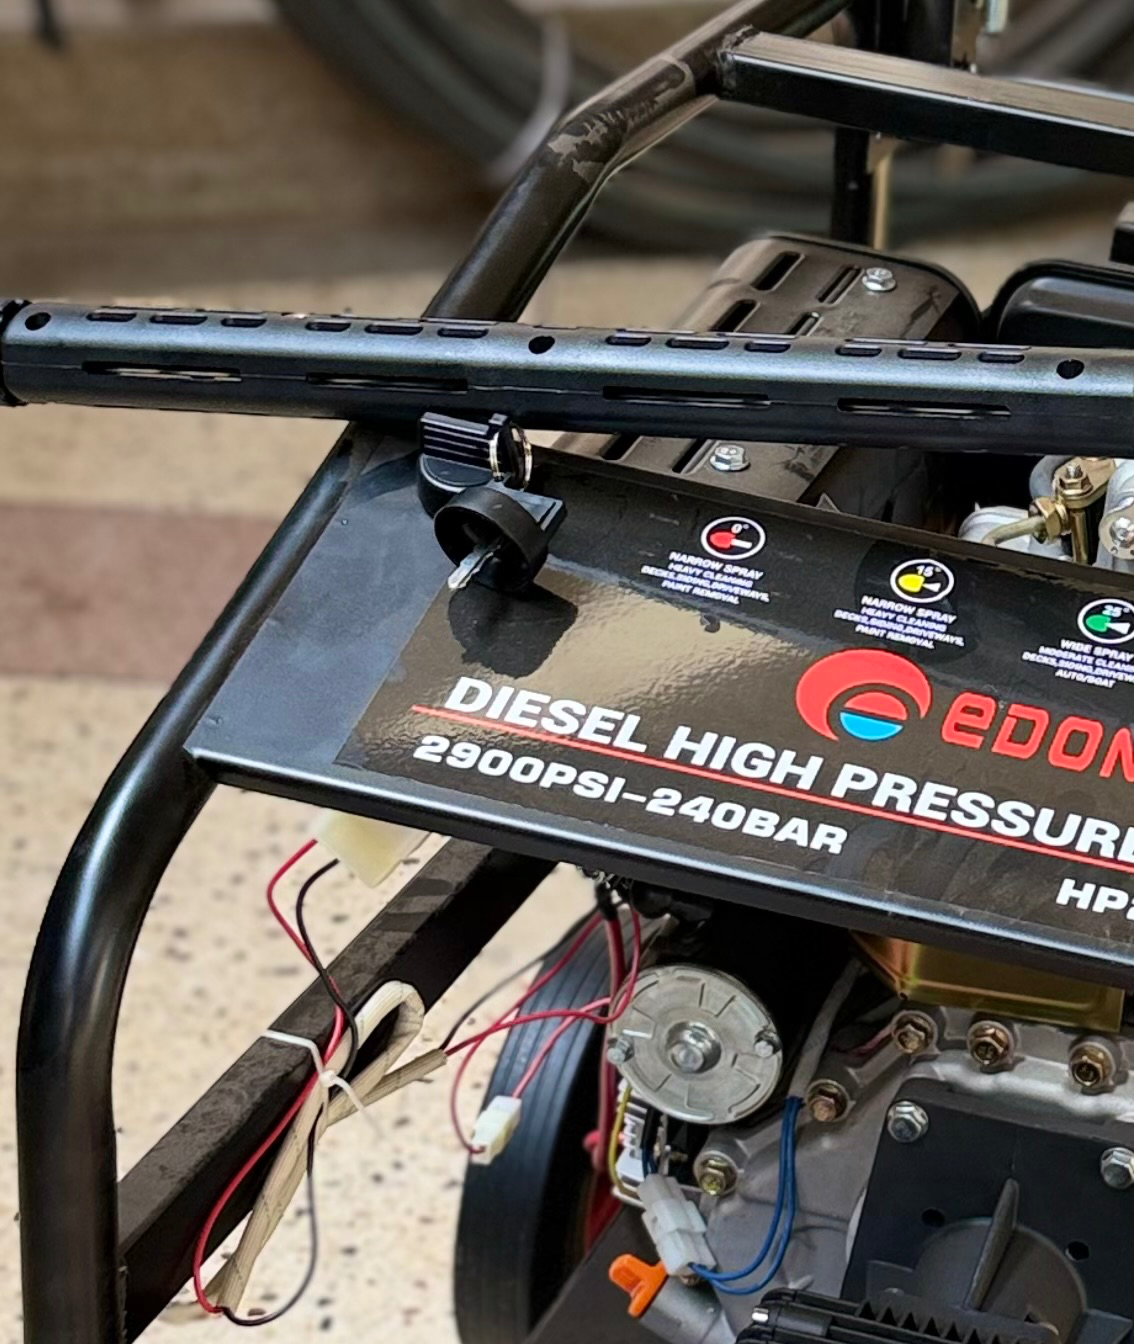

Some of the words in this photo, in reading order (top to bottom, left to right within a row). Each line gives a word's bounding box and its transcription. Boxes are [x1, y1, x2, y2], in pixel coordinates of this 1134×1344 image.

[668, 562, 703, 576] HEAVY
[702, 570, 754, 588] CLEANING
[669, 551, 723, 570] NARROW
[723, 564, 764, 580] SPRAY
[661, 579, 693, 593] PAINT
[692, 586, 740, 605] REMOVAL
[860, 606, 896, 620] HEAVY
[896, 615, 947, 633] CLEANING
[861, 595, 916, 615] NARROW
[915, 608, 958, 624] SPRAY
[855, 624, 887, 637] PAINT
[886, 632, 935, 649] REMOVAL
[1038, 645, 1095, 664] MODERATE
[1060, 639, 1092, 653] WIDE
[1093, 646, 1134, 662] SPRAY
[1055, 669, 1116, 689] AUTO/BOAT
[444, 676, 649, 753] DIESEL
[662, 726, 825, 791] HIGH
[412, 735, 850, 855] 2900PSI-240BAR
